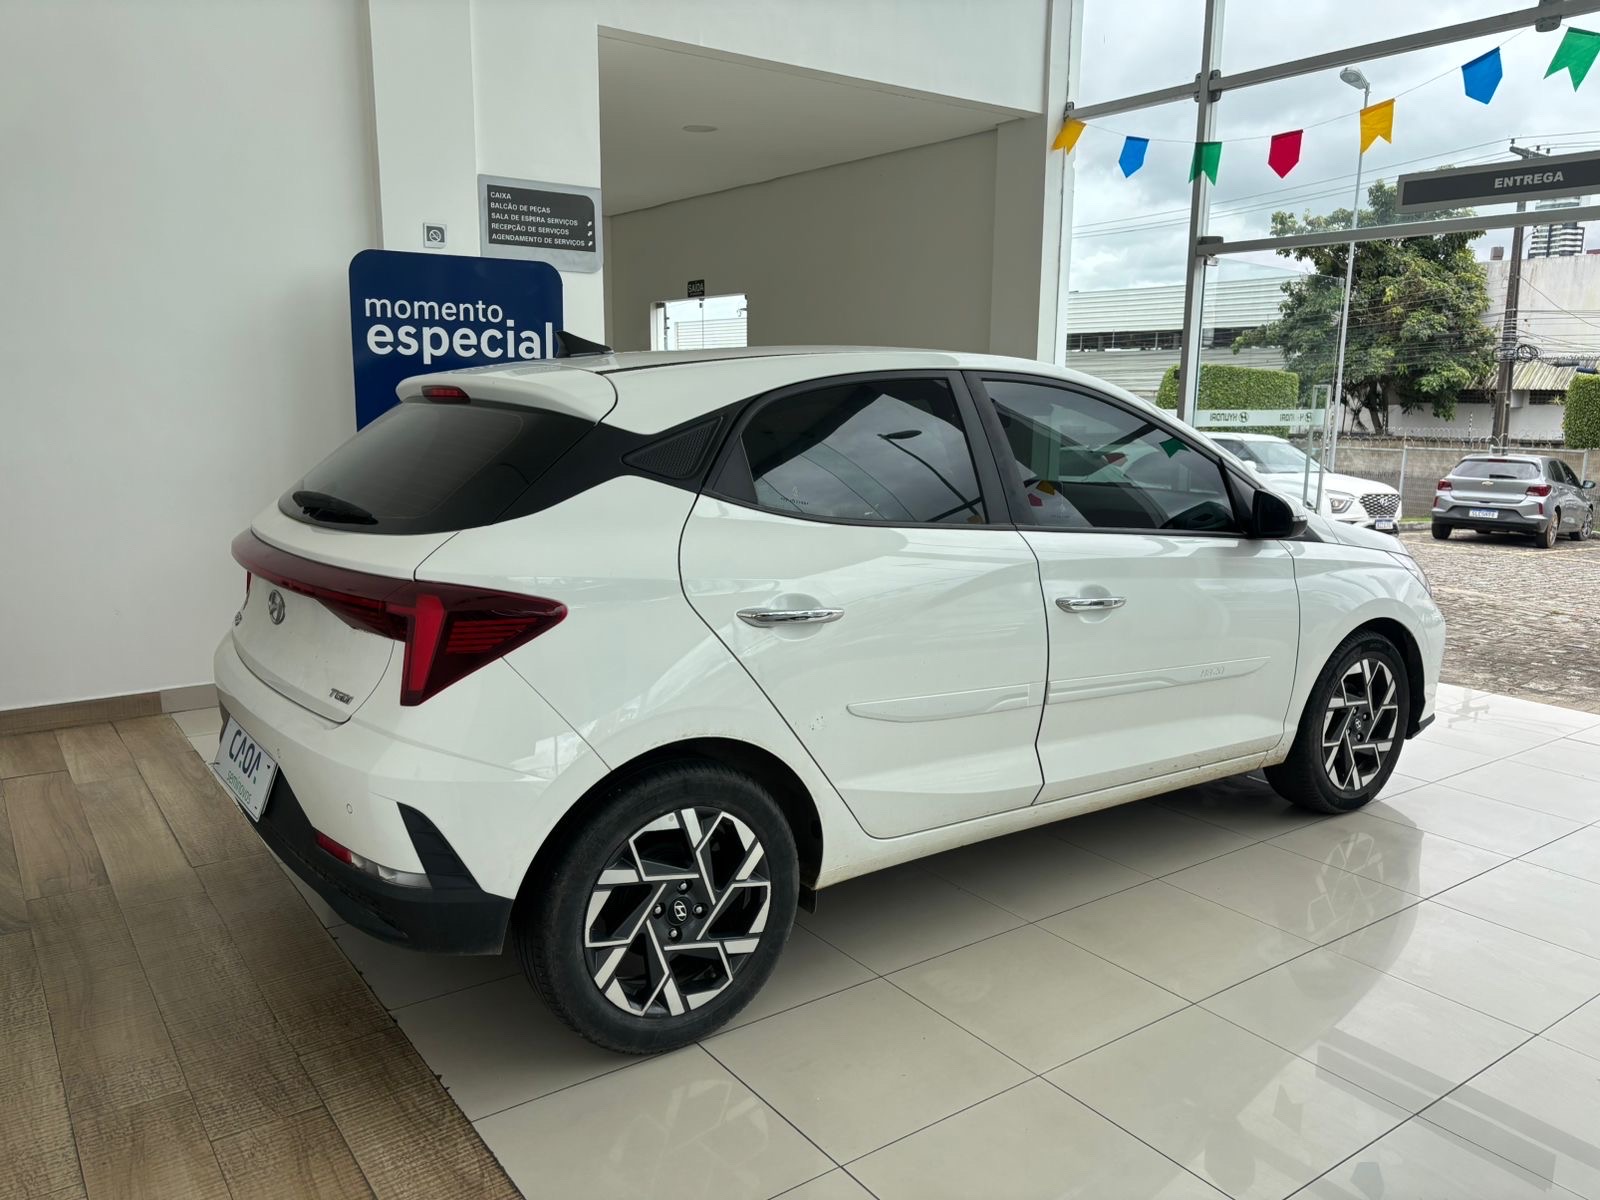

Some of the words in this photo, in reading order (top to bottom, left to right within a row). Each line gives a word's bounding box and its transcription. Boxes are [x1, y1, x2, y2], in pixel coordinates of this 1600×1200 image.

[1494, 171, 1564, 189] ENTREGA
[490, 191, 512, 199] CAIXA
[490, 202, 518, 210] BALCÃO
[519, 204, 528, 212] DE
[529, 206, 551, 214] PEÇAS
[491, 212, 509, 220] SALA
[521, 215, 546, 223] ESPERA
[547, 217, 578, 226] SERVIÇOS
[491, 222, 526, 232] RECEPÇÃO
[527, 225, 537, 233] DE
[538, 227, 570, 235] SERVIÇOS
[492, 233, 543, 243] AGENDAMENTO
[554, 238, 585, 247] SERVIÇOS
[364, 298, 503, 323] momento
[366, 319, 554, 365] especial
[229, 729, 262, 784] CAOA
